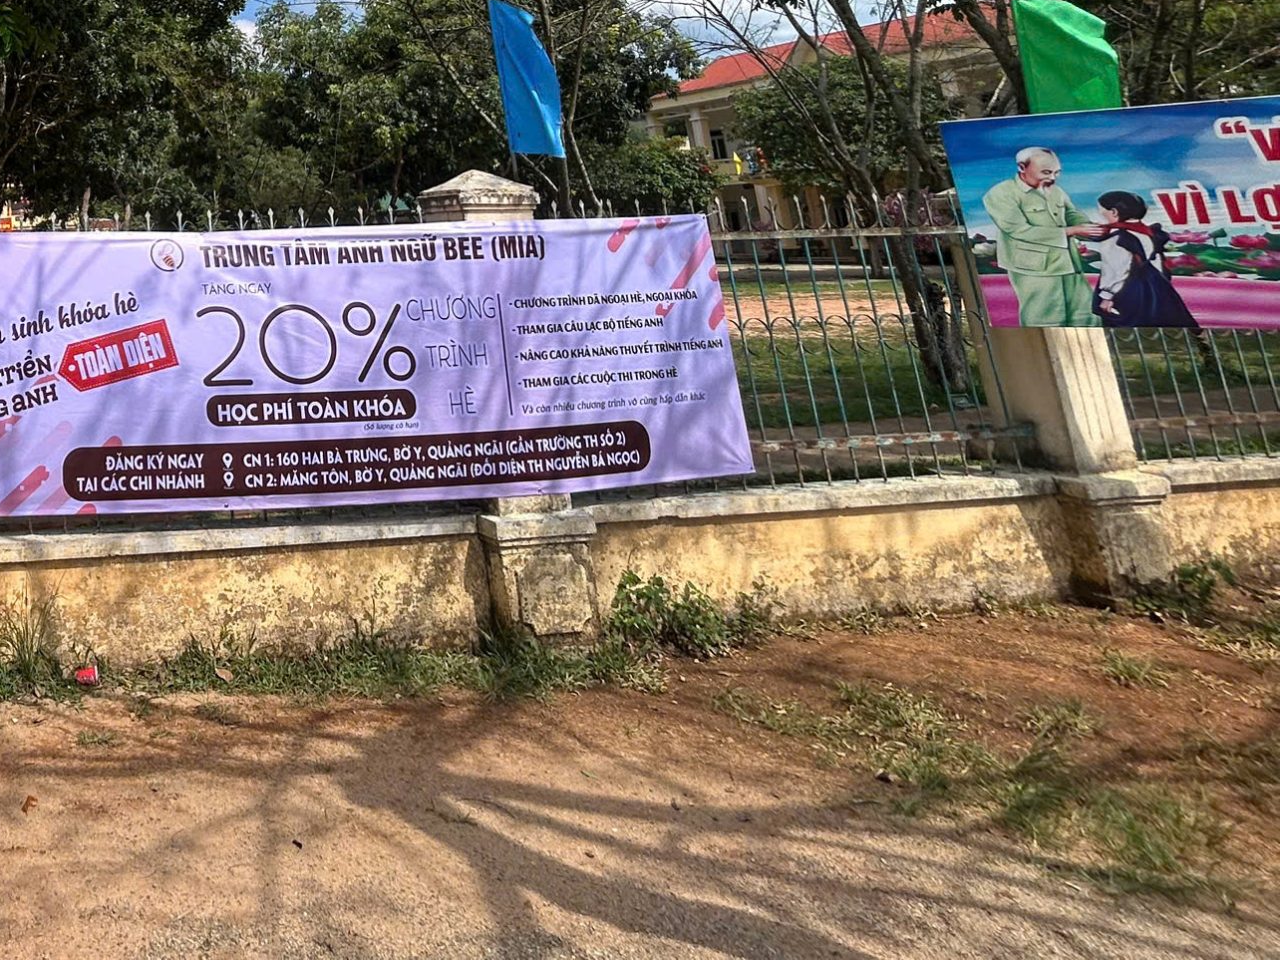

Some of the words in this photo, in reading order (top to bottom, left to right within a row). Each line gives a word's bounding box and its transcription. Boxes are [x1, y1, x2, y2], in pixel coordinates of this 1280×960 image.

[1220, 120, 1280, 162] “V
[1157, 184, 1211, 225] VÌ
[200, 243, 276, 269] TRUNG
[280, 238, 331, 266] TÂM
[337, 239, 384, 265] ANH
[389, 233, 437, 263] NGỮ
[443, 236, 484, 261] BEE
[492, 233, 545, 262] (MIA)
[238, 282, 272, 295] NGAY
[557, 294, 586, 307] TRÌNH
[587, 293, 601, 305] DÃ
[601, 294, 629, 306] NGOẠI
[630, 290, 645, 304] HÈ,
[646, 292, 673, 304] NGOẠI
[674, 288, 698, 301] KHÓA
[12, 310, 54, 341] sinh
[58, 303, 111, 330] khóa
[113, 292, 140, 316] hè
[405, 296, 497, 322] CHƯƠNG
[516, 324, 545, 335] THAM
[546, 323, 564, 334] GIA
[564, 320, 584, 332] CÂU
[585, 321, 602, 334] LẠC
[603, 318, 616, 332] BỘ
[617, 316, 643, 329] TIẾNG
[644, 318, 664, 328] ANH
[73, 344, 124, 381] TOÀN
[122, 331, 167, 369] DIỆN
[196, 301, 417, 387] 20%
[425, 341, 489, 368] TRÌNH
[519, 349, 548, 361] NÂNG
[549, 348, 569, 360] CAO
[570, 345, 592, 359] KHẢ
[619, 340, 653, 356] THUYẾT
[654, 340, 683, 353] TRÌNH
[683, 337, 707, 351] TIẾNG
[707, 339, 724, 349] ANH
[522, 377, 552, 389] THAM
[552, 376, 570, 387] GIA
[570, 372, 590, 385] CÁC
[590, 370, 618, 385] CUỘC
[617, 372, 633, 382] THI
[634, 369, 666, 381] TRONG
[666, 365, 679, 378] HÈ
[217, 403, 259, 425] HỌC
[262, 398, 293, 420] PHÍ
[297, 396, 350, 420] TOÀN
[353, 394, 408, 418] KHÓA
[449, 386, 477, 416] HÈ
[521, 404, 534, 415] Và
[535, 403, 551, 413] còn
[576, 399, 606, 411] chương
[607, 397, 626, 408] trình
[639, 395, 658, 406] cùng
[105, 452, 144, 471] ĐĂNG
[147, 451, 165, 470] KÝ
[167, 452, 205, 469] NGAY
[243, 453, 262, 468] CN
[264, 453, 274, 467] 1:
[276, 451, 300, 466] 160
[301, 450, 325, 466] HAI
[326, 446, 344, 465] BÀ
[345, 446, 391, 464] TRƯNG,
[393, 444, 411, 461] BỜ
[412, 446, 426, 462] Y,
[427, 440, 472, 460] QUẢNG
[474, 439, 504, 457] NGÃI
[535, 434, 582, 452] TRƯỜNG
[583, 433, 599, 448] TH
[600, 428, 614, 447] SỐ
[615, 431, 626, 446] 2)
[244, 474, 264, 488] CN
[266, 473, 278, 488] 2:
[280, 469, 319, 487] MĂNG
[321, 468, 353, 486] TÔN,
[355, 465, 373, 483] BỜ
[375, 468, 388, 484] Y,
[389, 463, 435, 482] QUẢNG
[437, 462, 468, 480] NGÃI
[470, 457, 497, 478] (ĐỐI
[499, 458, 526, 477] DIỆN
[527, 459, 544, 474] TH
[545, 450, 590, 472] NGUYỄN
[591, 450, 606, 468] BÁ
[607, 449, 641, 467] NGỌC)
[76, 476, 98, 495] TẠI
[100, 472, 128, 492] CÁC
[129, 474, 153, 491] CHI
[155, 471, 206, 490] NHÁNH
